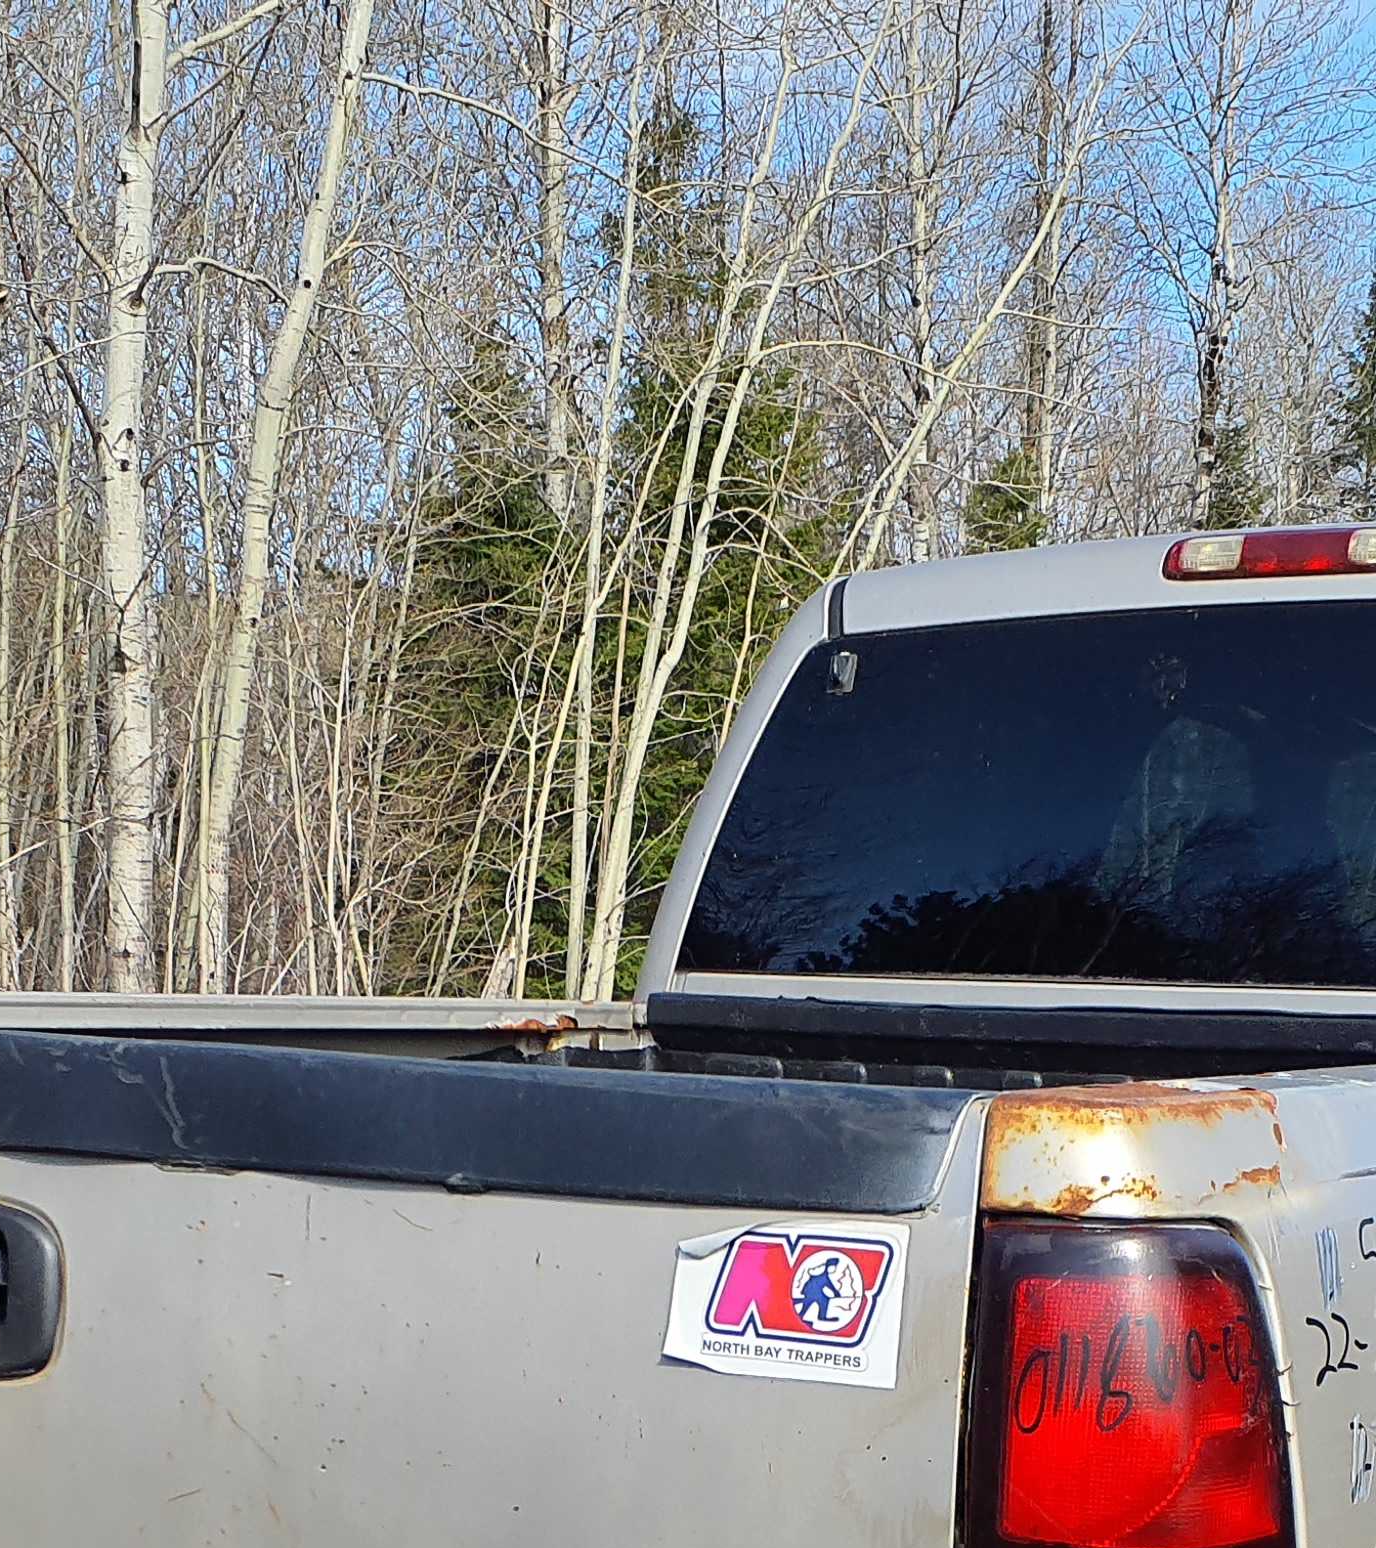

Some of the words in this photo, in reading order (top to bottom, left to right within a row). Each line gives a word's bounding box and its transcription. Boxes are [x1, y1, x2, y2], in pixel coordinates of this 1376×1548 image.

[702, 1339, 751, 1356] NORTH
[754, 1345, 783, 1360] BAY
[787, 1349, 862, 1368] TRAPPERS
